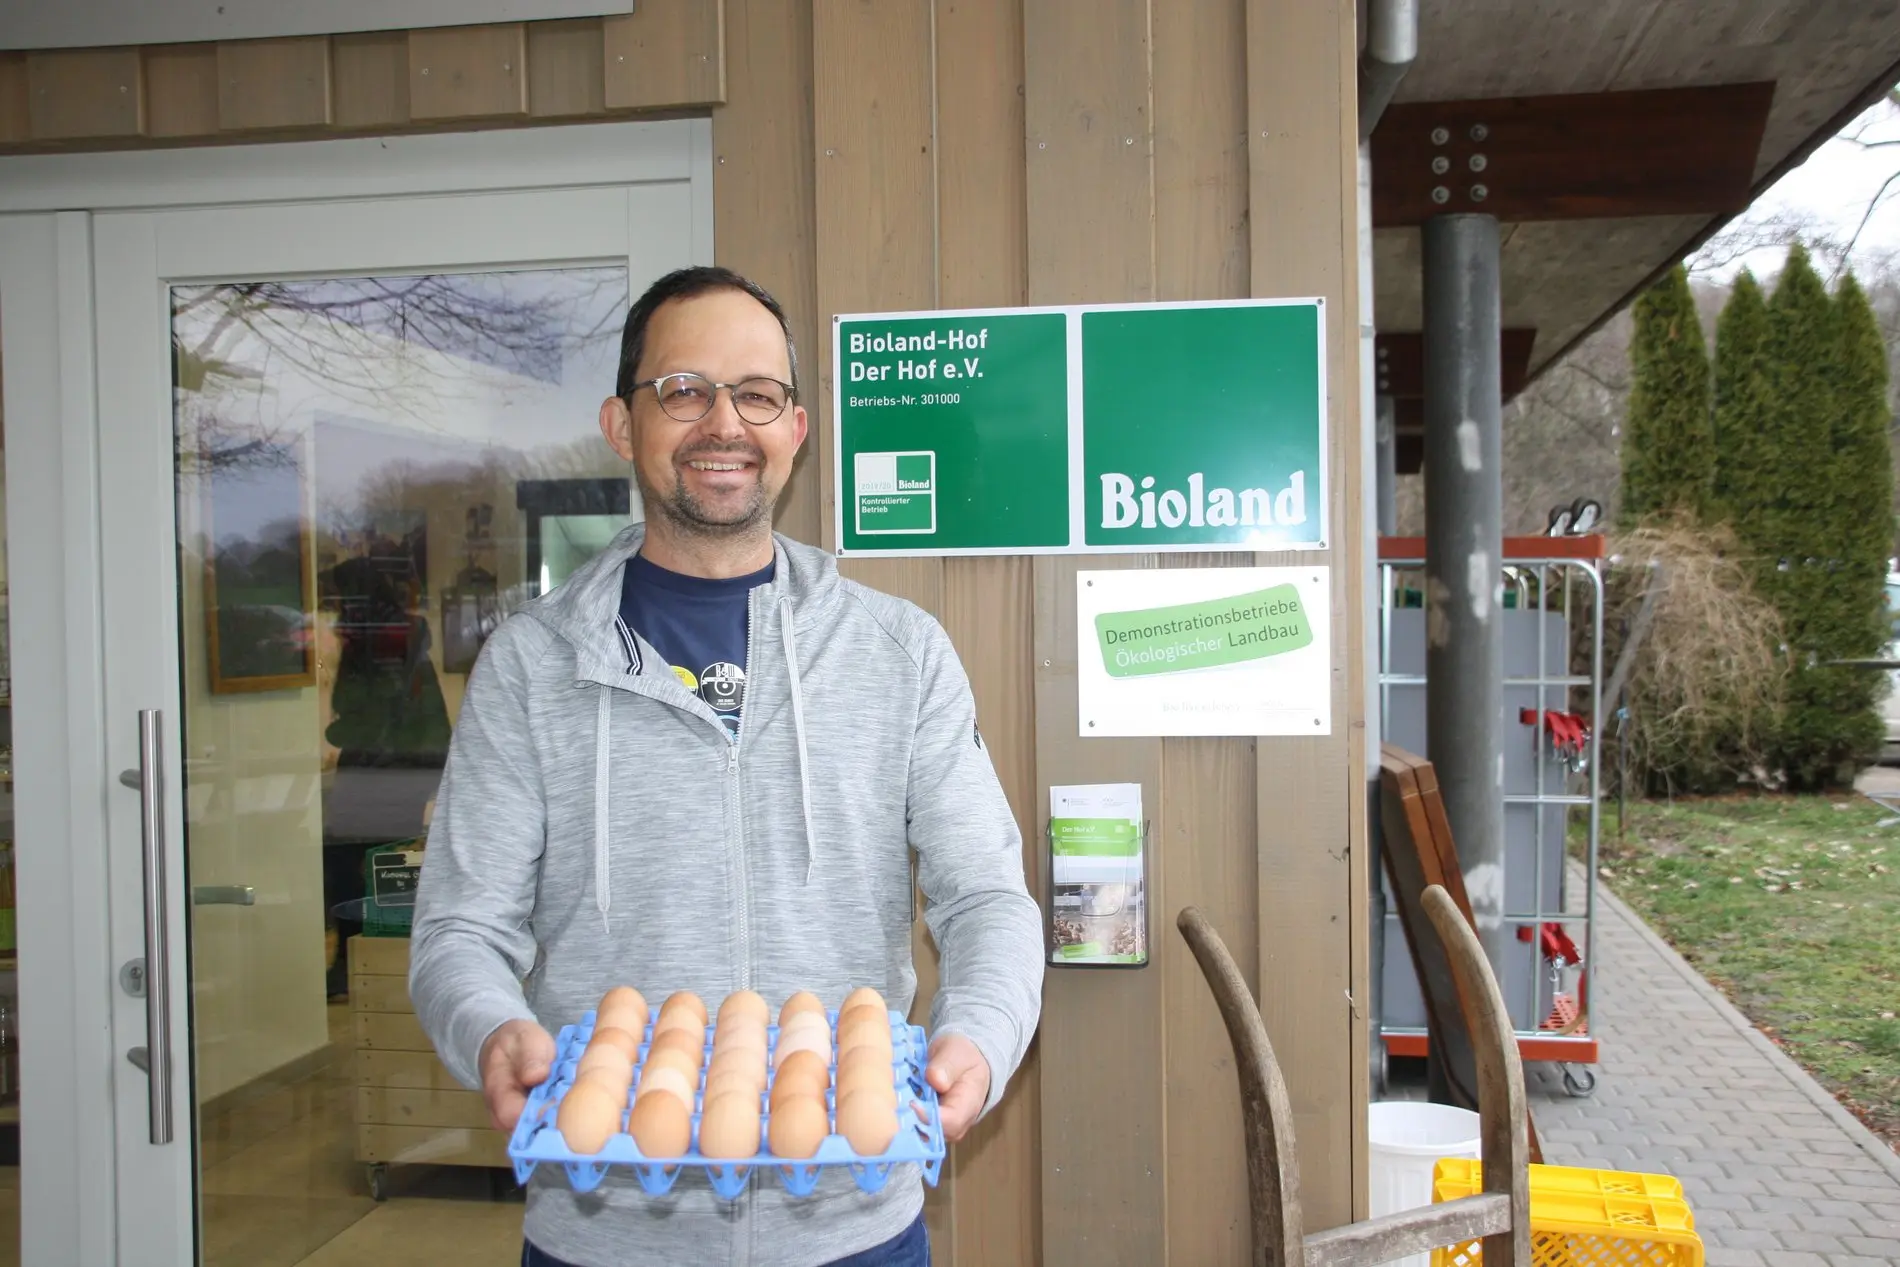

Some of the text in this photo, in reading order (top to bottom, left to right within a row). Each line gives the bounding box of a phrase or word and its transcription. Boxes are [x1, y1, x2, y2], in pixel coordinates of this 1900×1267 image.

[850, 328, 988, 353] Bioland-Hof
[850, 357, 983, 382] Der Hof e.V.
[849, 393, 960, 407] Betriebs-Nr. 301000
[898, 480, 930, 489] Bioland
[861, 497, 911, 505] Kontrollierter
[861, 506, 888, 514] Betrieb
[1100, 470, 1307, 529] Bioland
[1105, 599, 1298, 645] Demonstrationsbetriebe
[1115, 623, 1299, 667] Ökologischer Landbau
